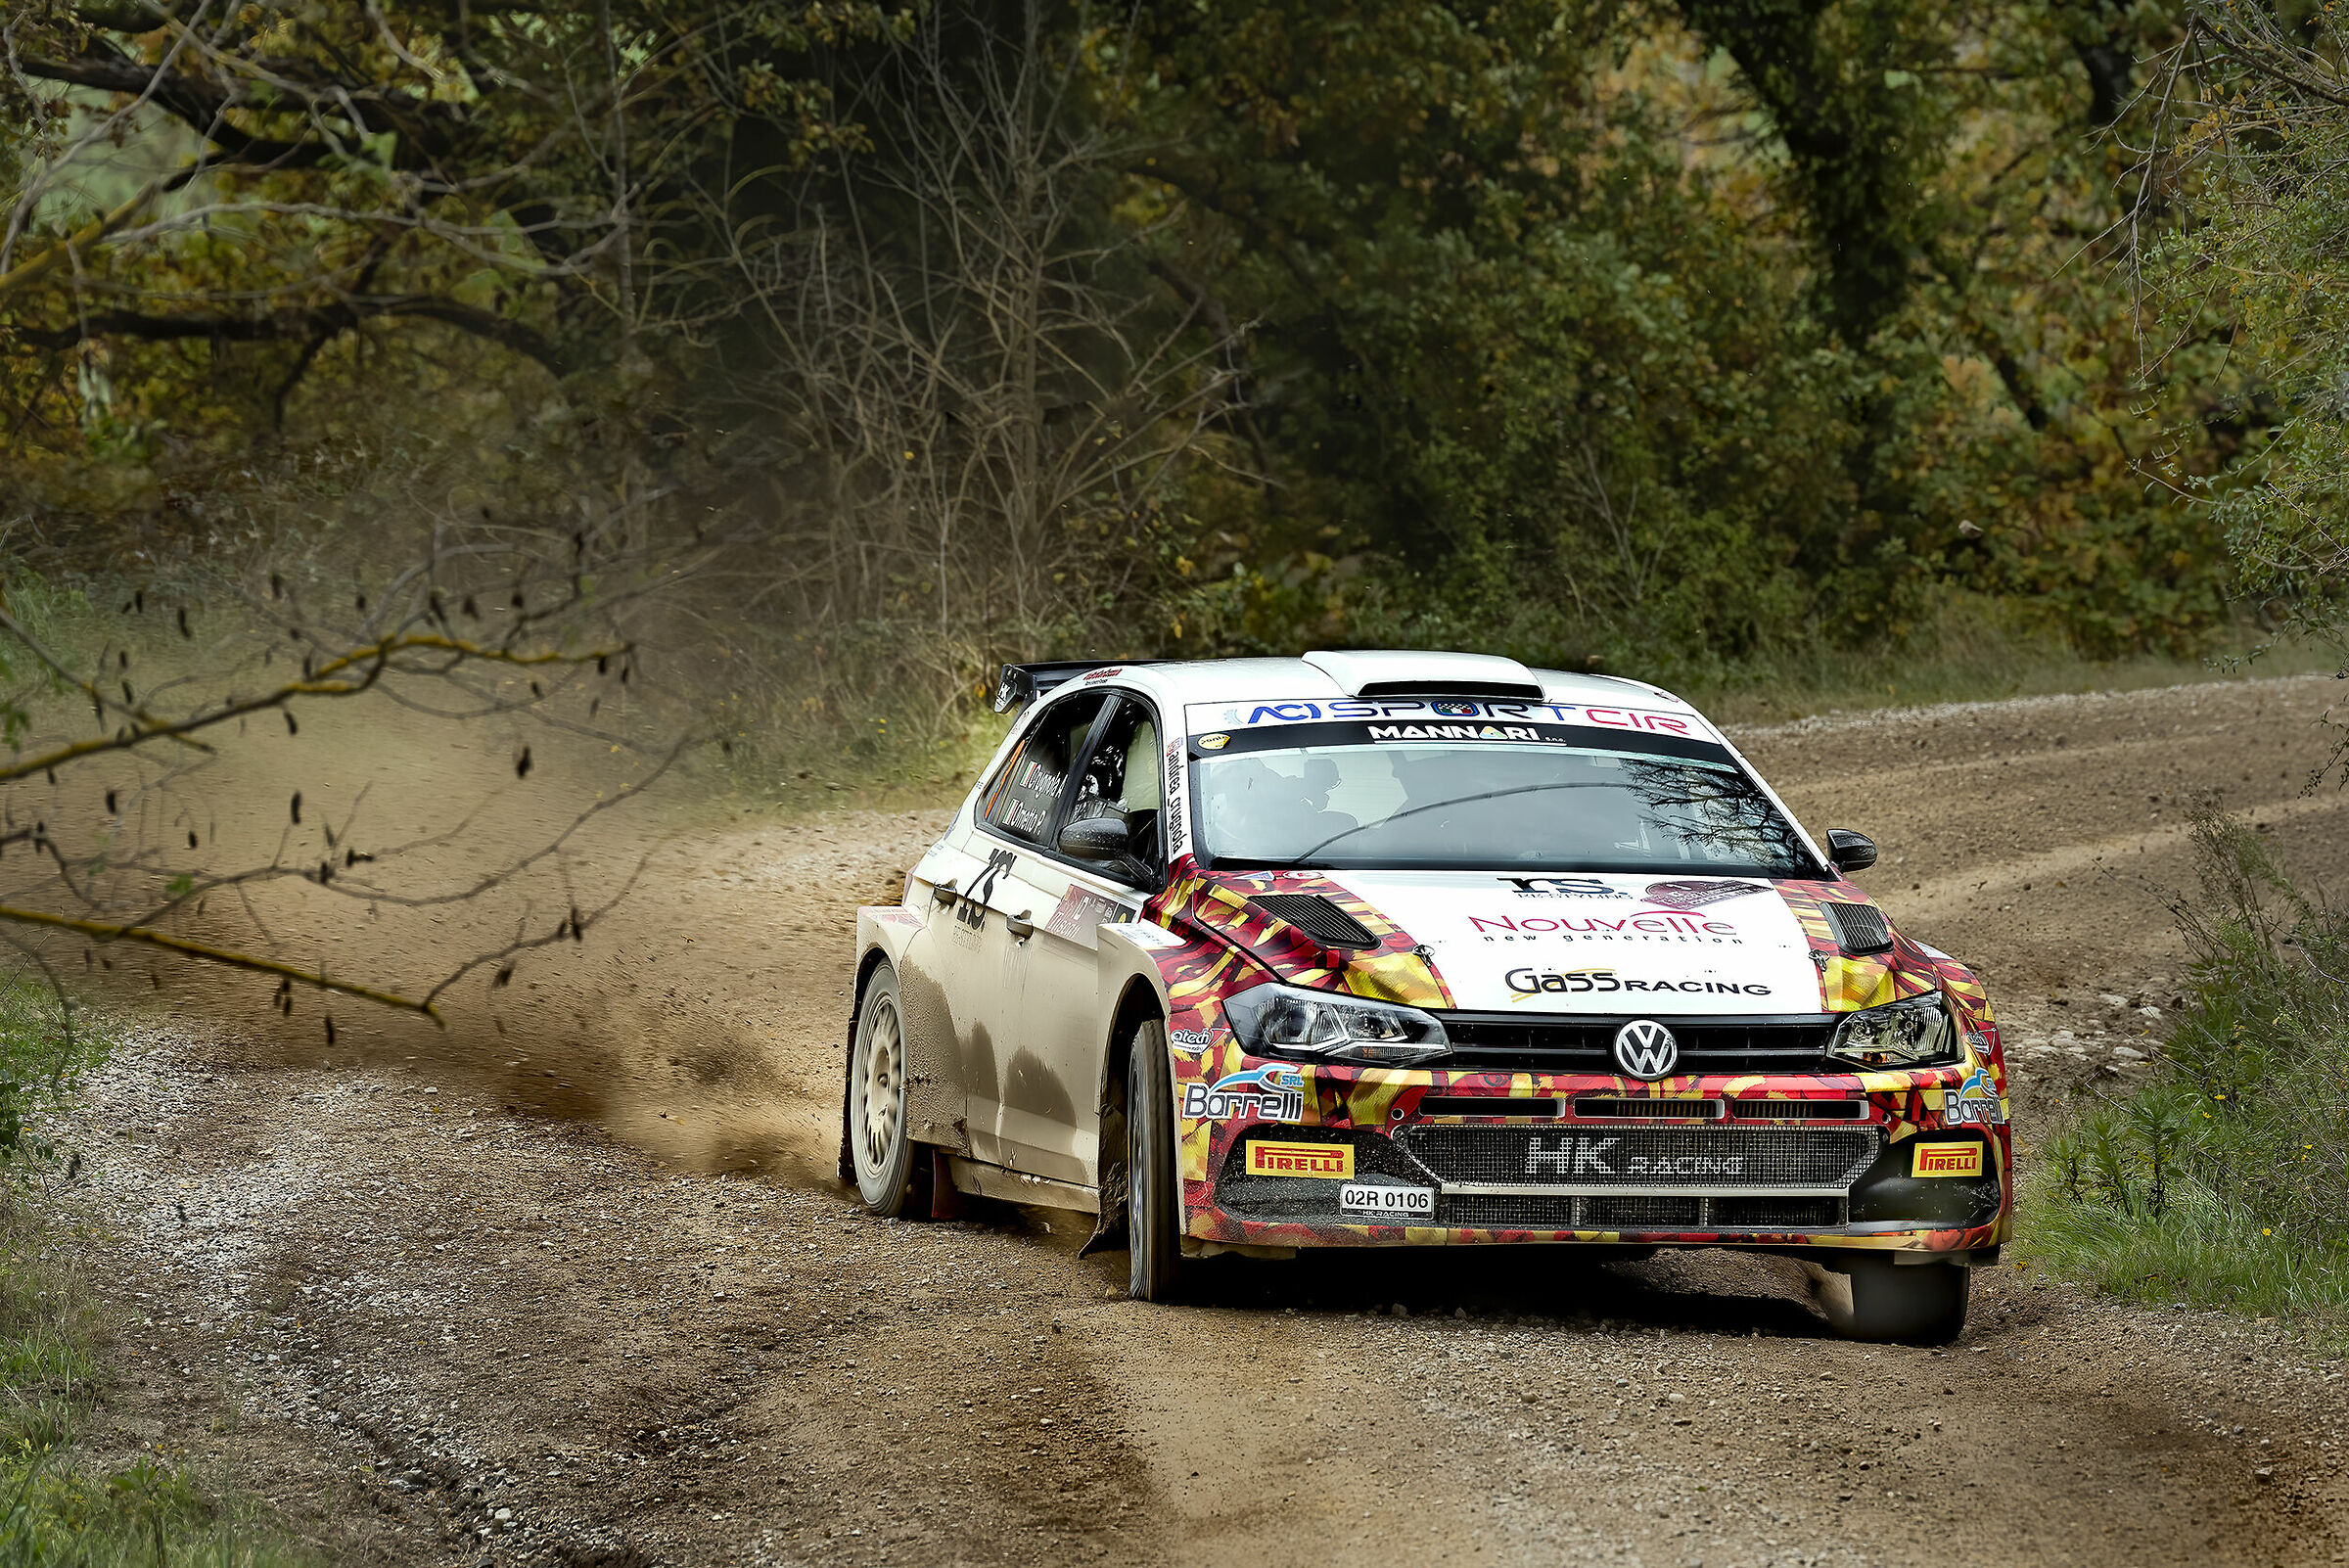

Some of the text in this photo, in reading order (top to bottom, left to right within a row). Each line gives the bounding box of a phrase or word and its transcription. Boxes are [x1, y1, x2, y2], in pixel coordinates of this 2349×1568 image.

[1248, 704, 1321, 723] ACI
[1586, 709, 1691, 735] CIR
[1367, 725, 1541, 741] MANNARI
[1468, 912, 1736, 935] Nouvelle
[1483, 934, 1742, 945] new generation
[1280, 1074, 1304, 1086] SRL
[1255, 1146, 1345, 1173] PIRELLI
[1525, 1137, 1744, 1175] HK RACING
[1919, 1147, 1978, 1172] PIRELLI
[1345, 1189, 1428, 1209] 02R 0106
